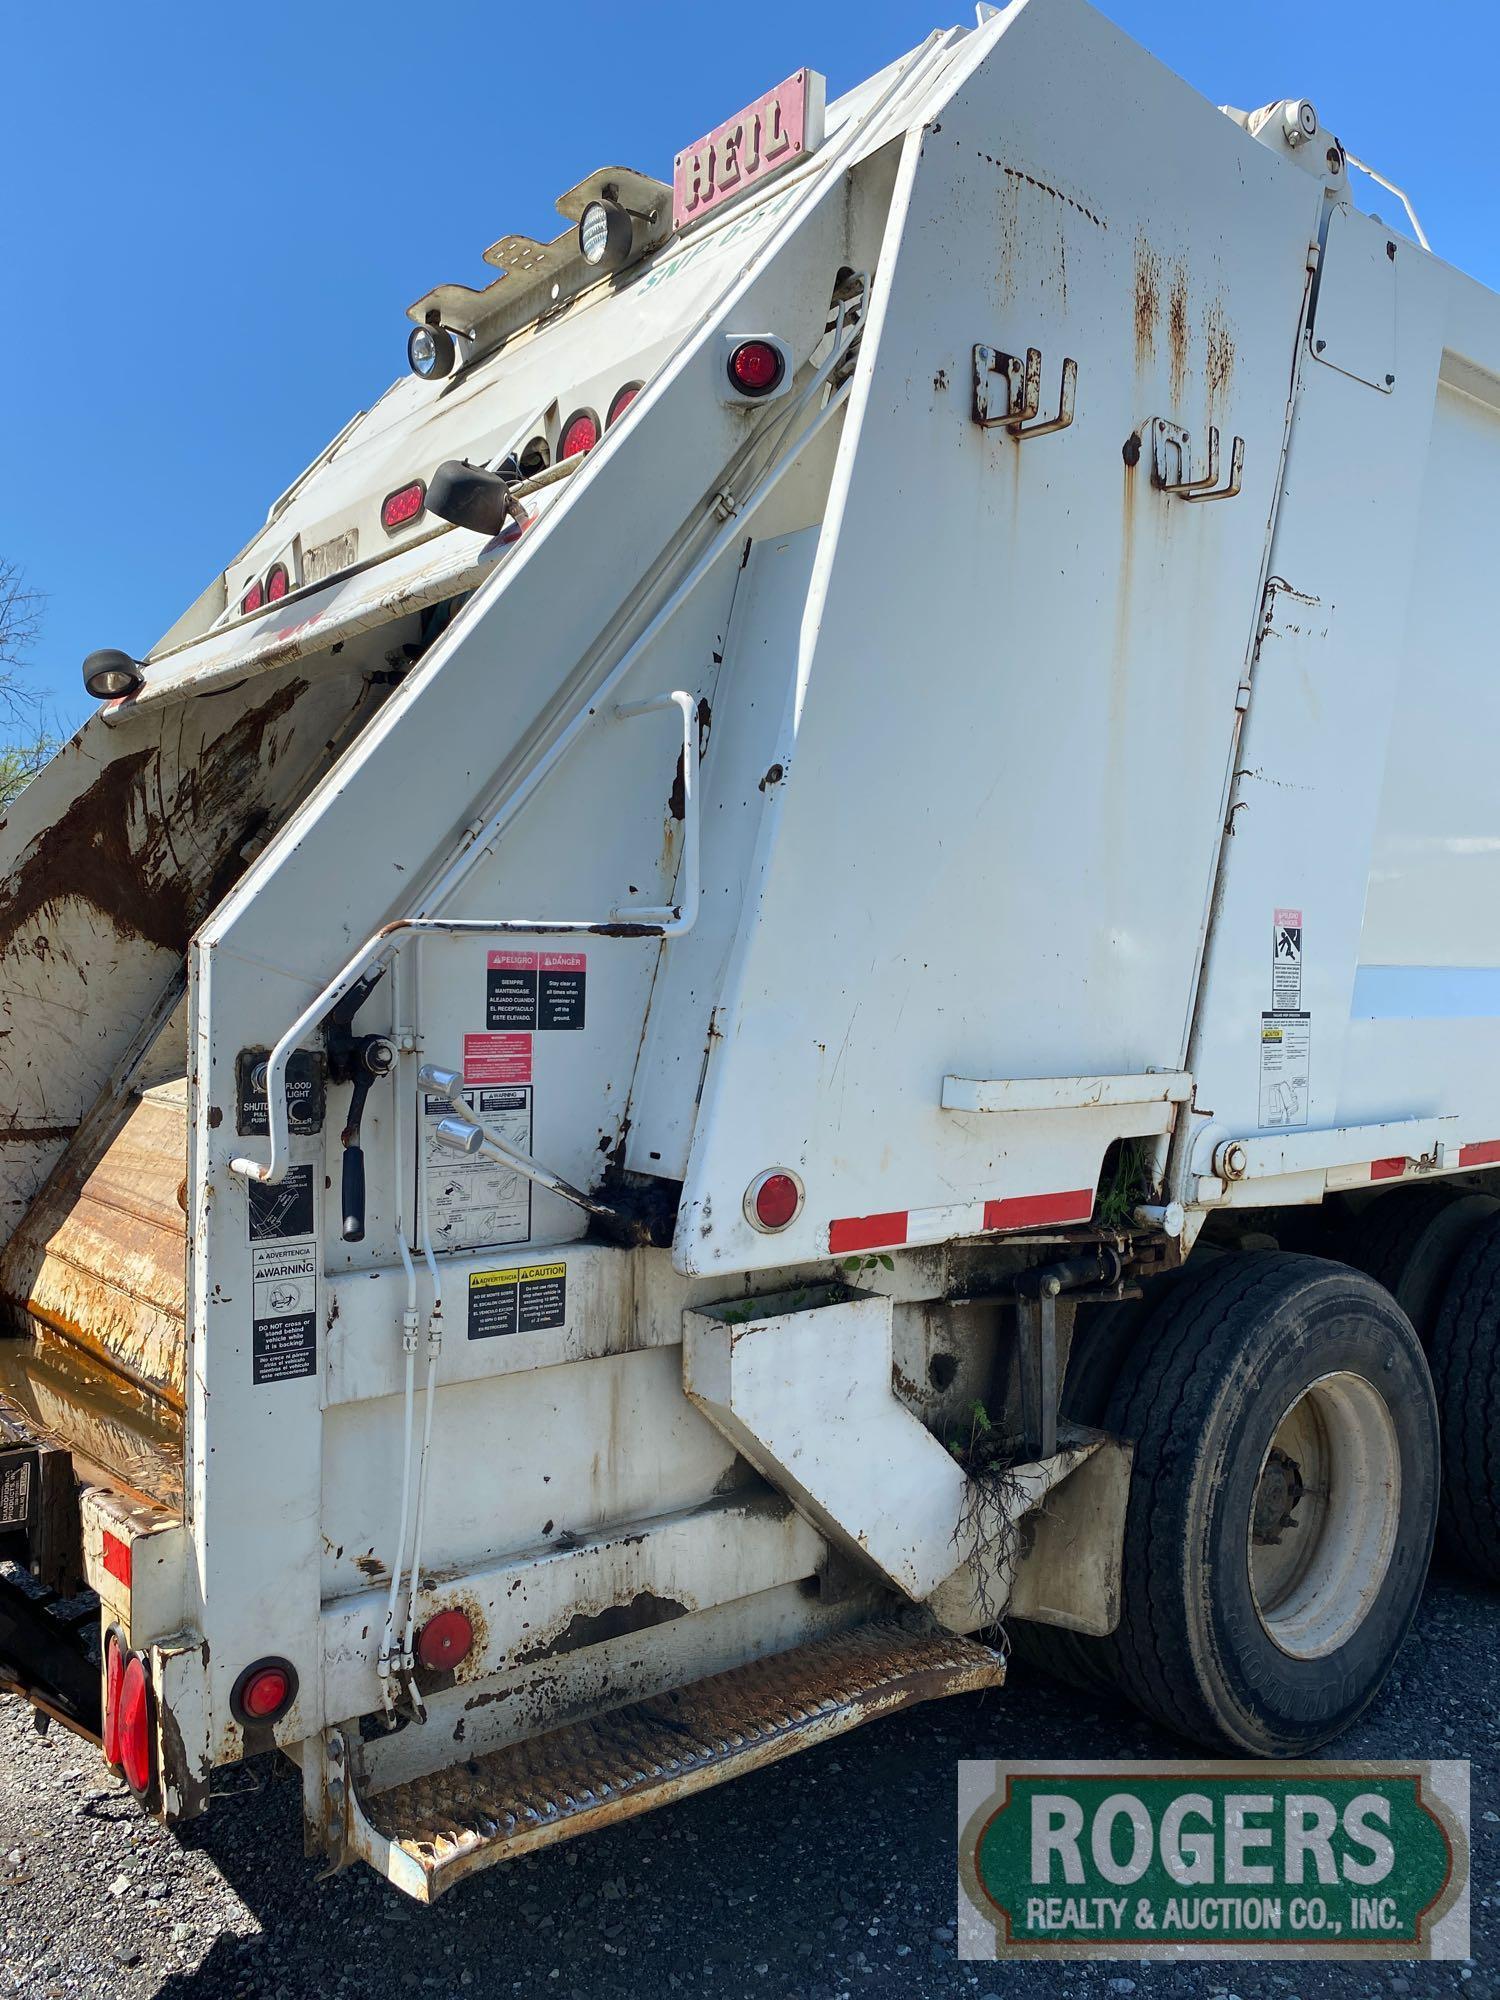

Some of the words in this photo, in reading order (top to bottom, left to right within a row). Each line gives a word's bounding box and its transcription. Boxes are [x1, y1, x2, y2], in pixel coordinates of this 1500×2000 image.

[685, 100, 790, 212] HEIL
[501, 956, 533, 964] PELIGRO
[552, 957, 581, 966] DANGER
[287, 1090, 310, 1098] LIGHT
[243, 1102, 269, 1111] SHUTD
[266, 1249, 310, 1259] ADVERTENCIA
[264, 1263, 314, 1277] WARNING
[528, 1266, 564, 1278] CAUTION
[480, 1274, 517, 1284] ADVERTENCIA
[284, 1326, 304, 1334] behind
